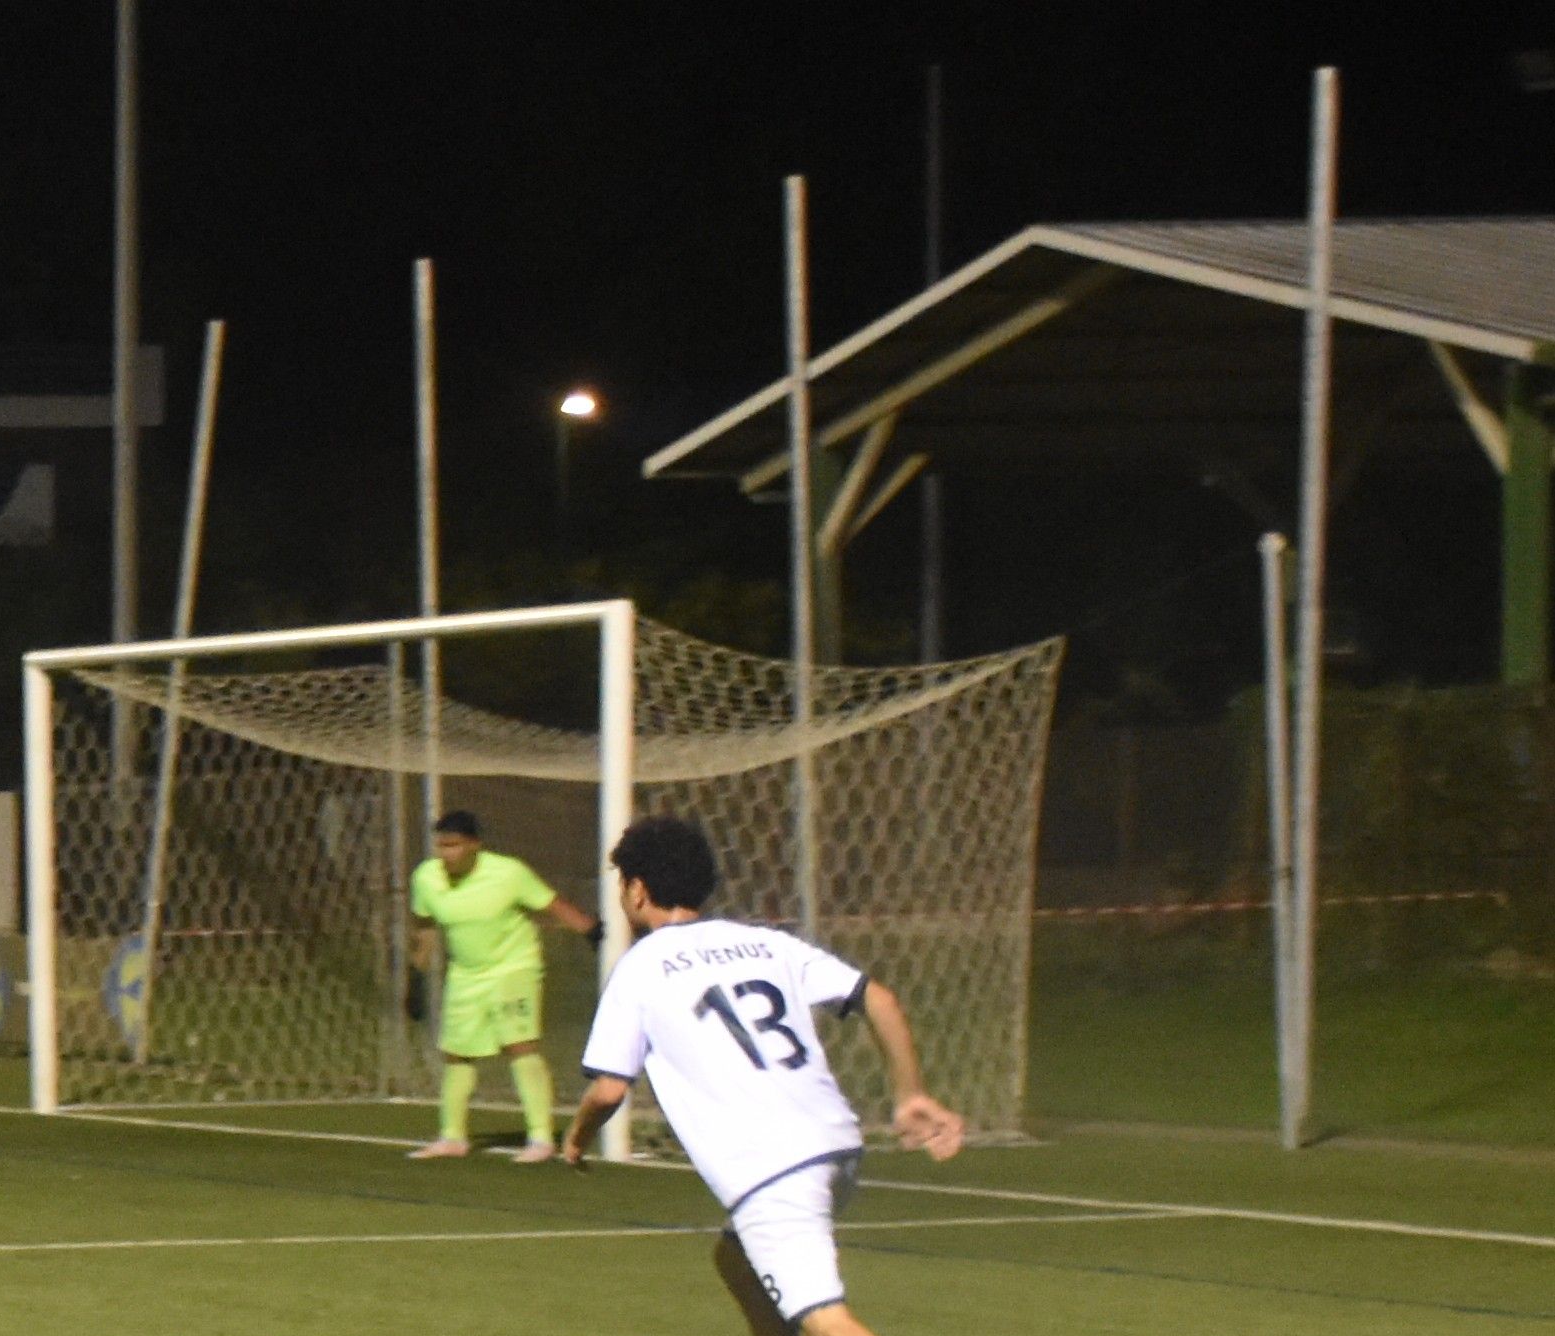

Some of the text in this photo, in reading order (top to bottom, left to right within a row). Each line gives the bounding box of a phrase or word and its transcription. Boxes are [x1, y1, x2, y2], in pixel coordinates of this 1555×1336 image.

[662, 943, 773, 978] AS VENUS
[692, 979, 808, 1071] 13
